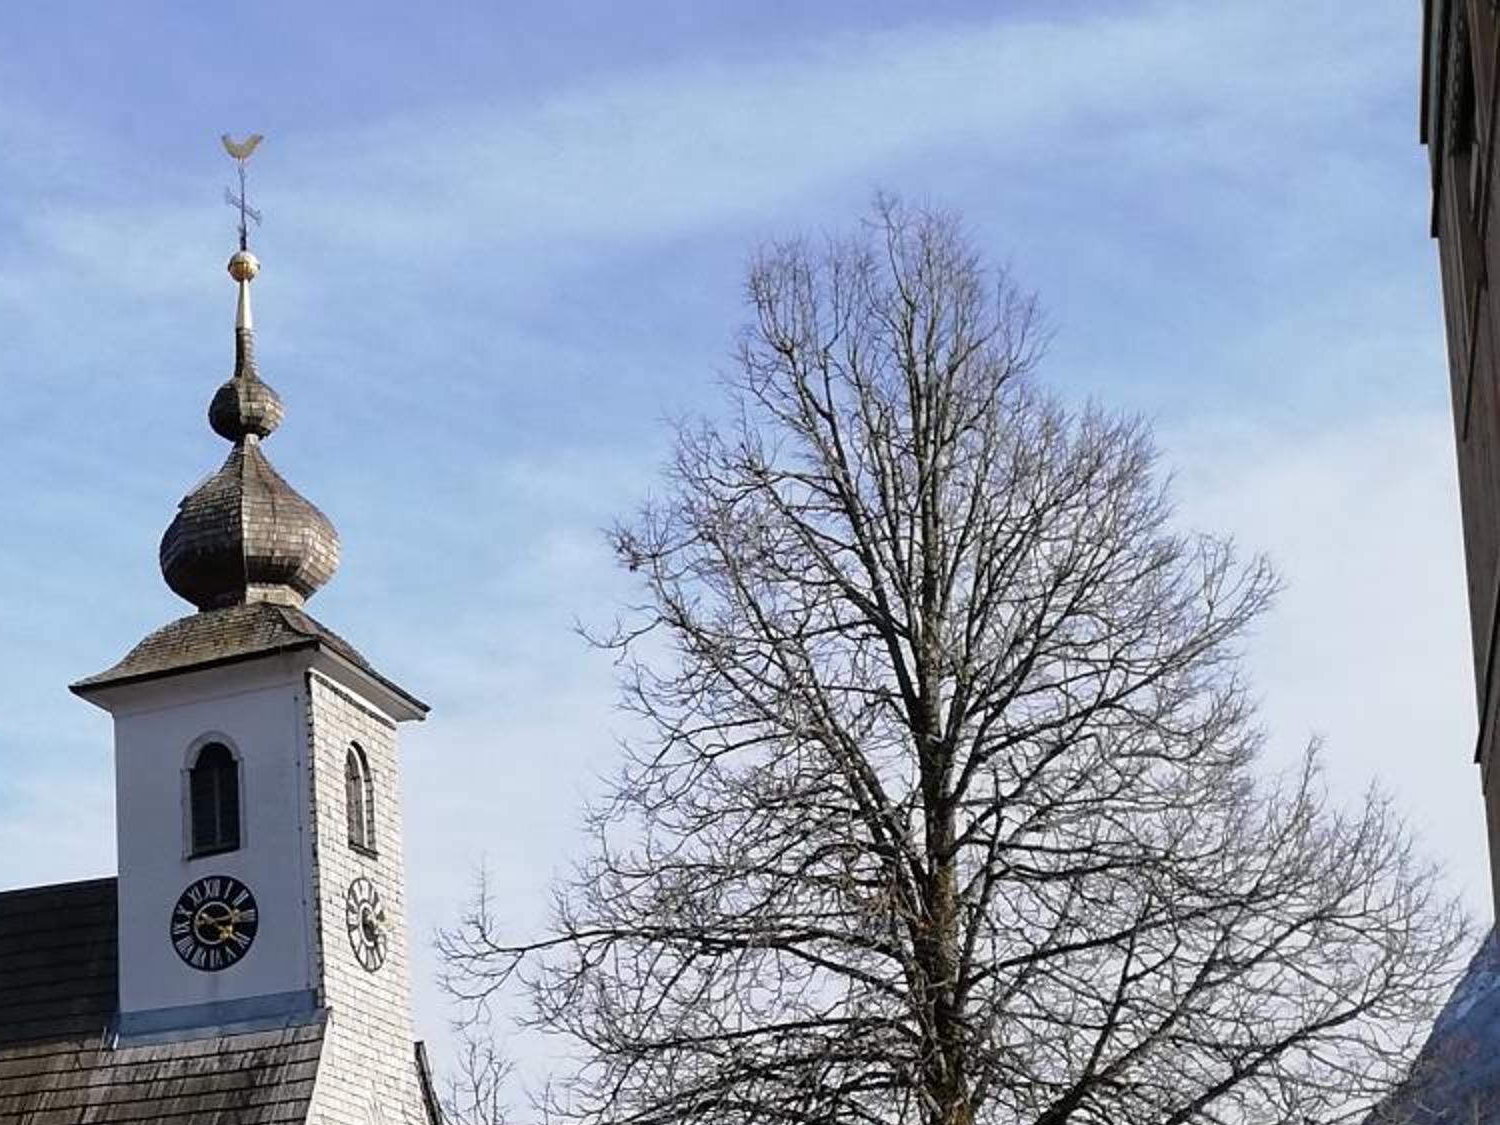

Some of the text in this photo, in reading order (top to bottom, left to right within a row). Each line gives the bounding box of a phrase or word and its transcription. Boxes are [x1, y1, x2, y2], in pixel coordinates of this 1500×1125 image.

[203, 879, 221, 898] XII
[223, 880, 234, 899] I
[232, 889, 250, 907] II
